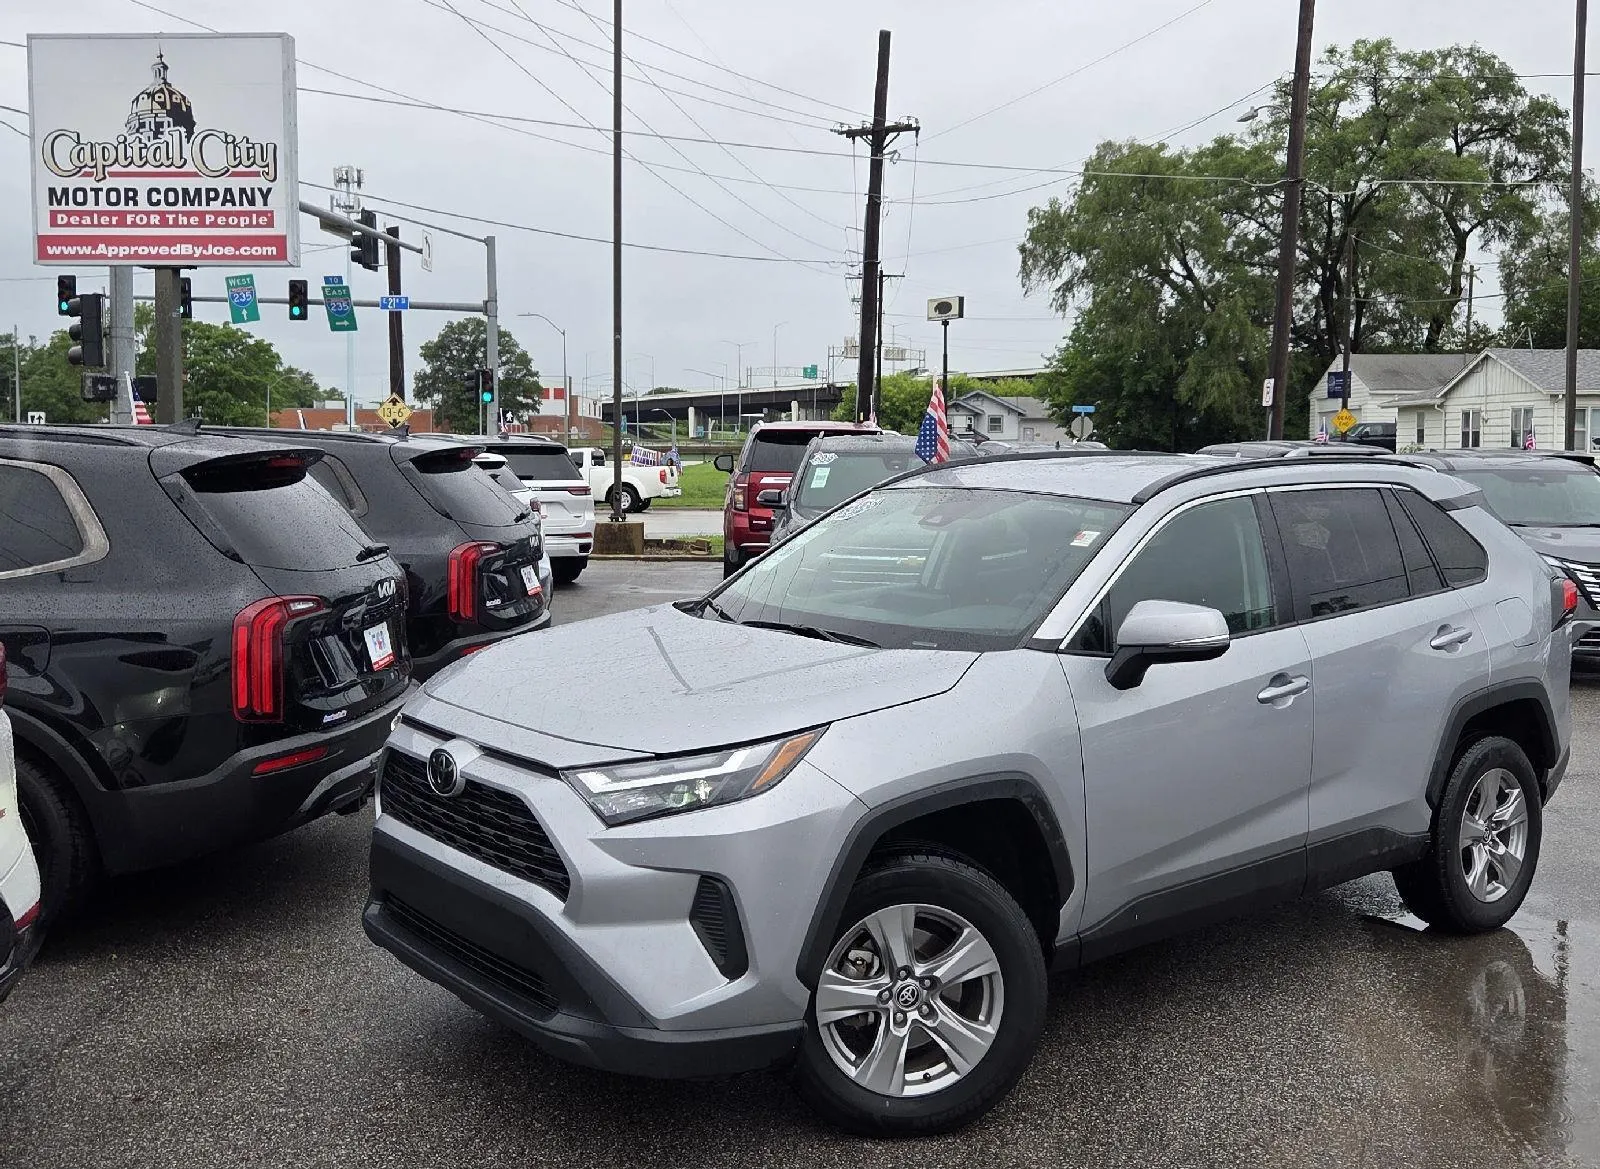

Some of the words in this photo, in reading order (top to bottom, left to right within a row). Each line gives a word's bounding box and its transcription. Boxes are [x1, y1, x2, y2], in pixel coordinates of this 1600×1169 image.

[42, 129, 187, 181] Capital
[191, 129, 277, 182] City
[48, 187, 138, 207] MOTOR
[147, 187, 272, 207] COMPANY
[57, 214, 118, 225] Dealer
[126, 214, 160, 225] FOR
[166, 214, 199, 225] The
[47, 244, 277, 257] www.ApprovedByJoe.com
[233, 292, 252, 302] 235
[331, 302, 348, 311] 235
